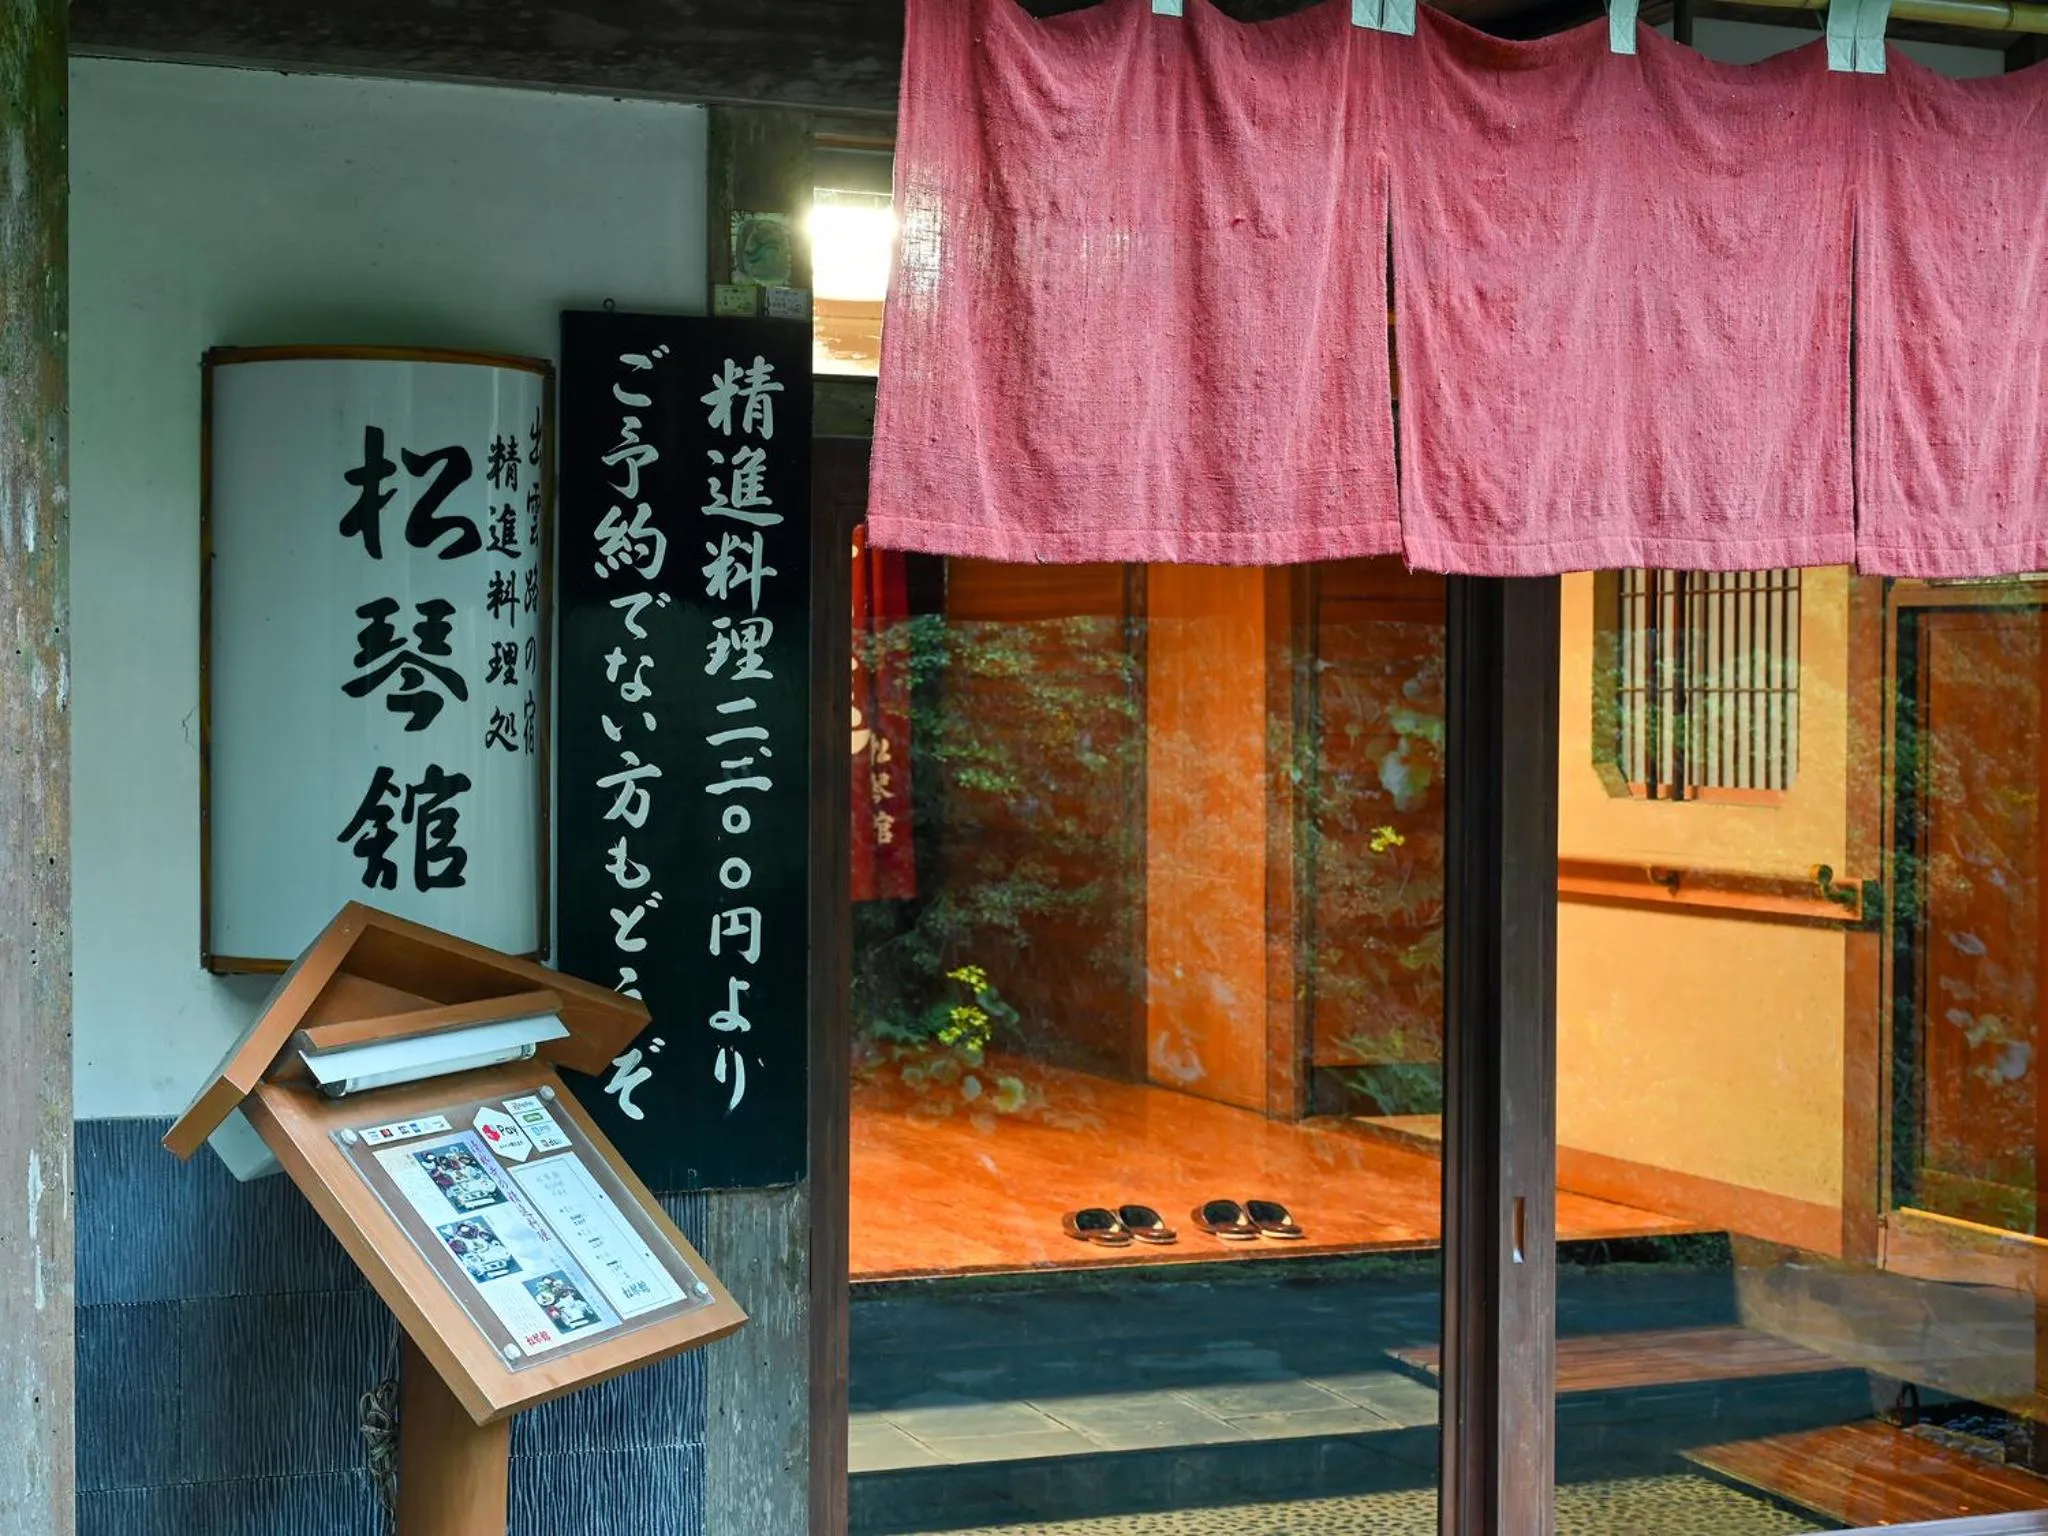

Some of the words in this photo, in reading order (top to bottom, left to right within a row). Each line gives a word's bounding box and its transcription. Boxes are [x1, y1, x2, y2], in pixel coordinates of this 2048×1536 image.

[337, 426, 482, 893] 松琴館
[485, 434, 522, 753] 精進料理処
